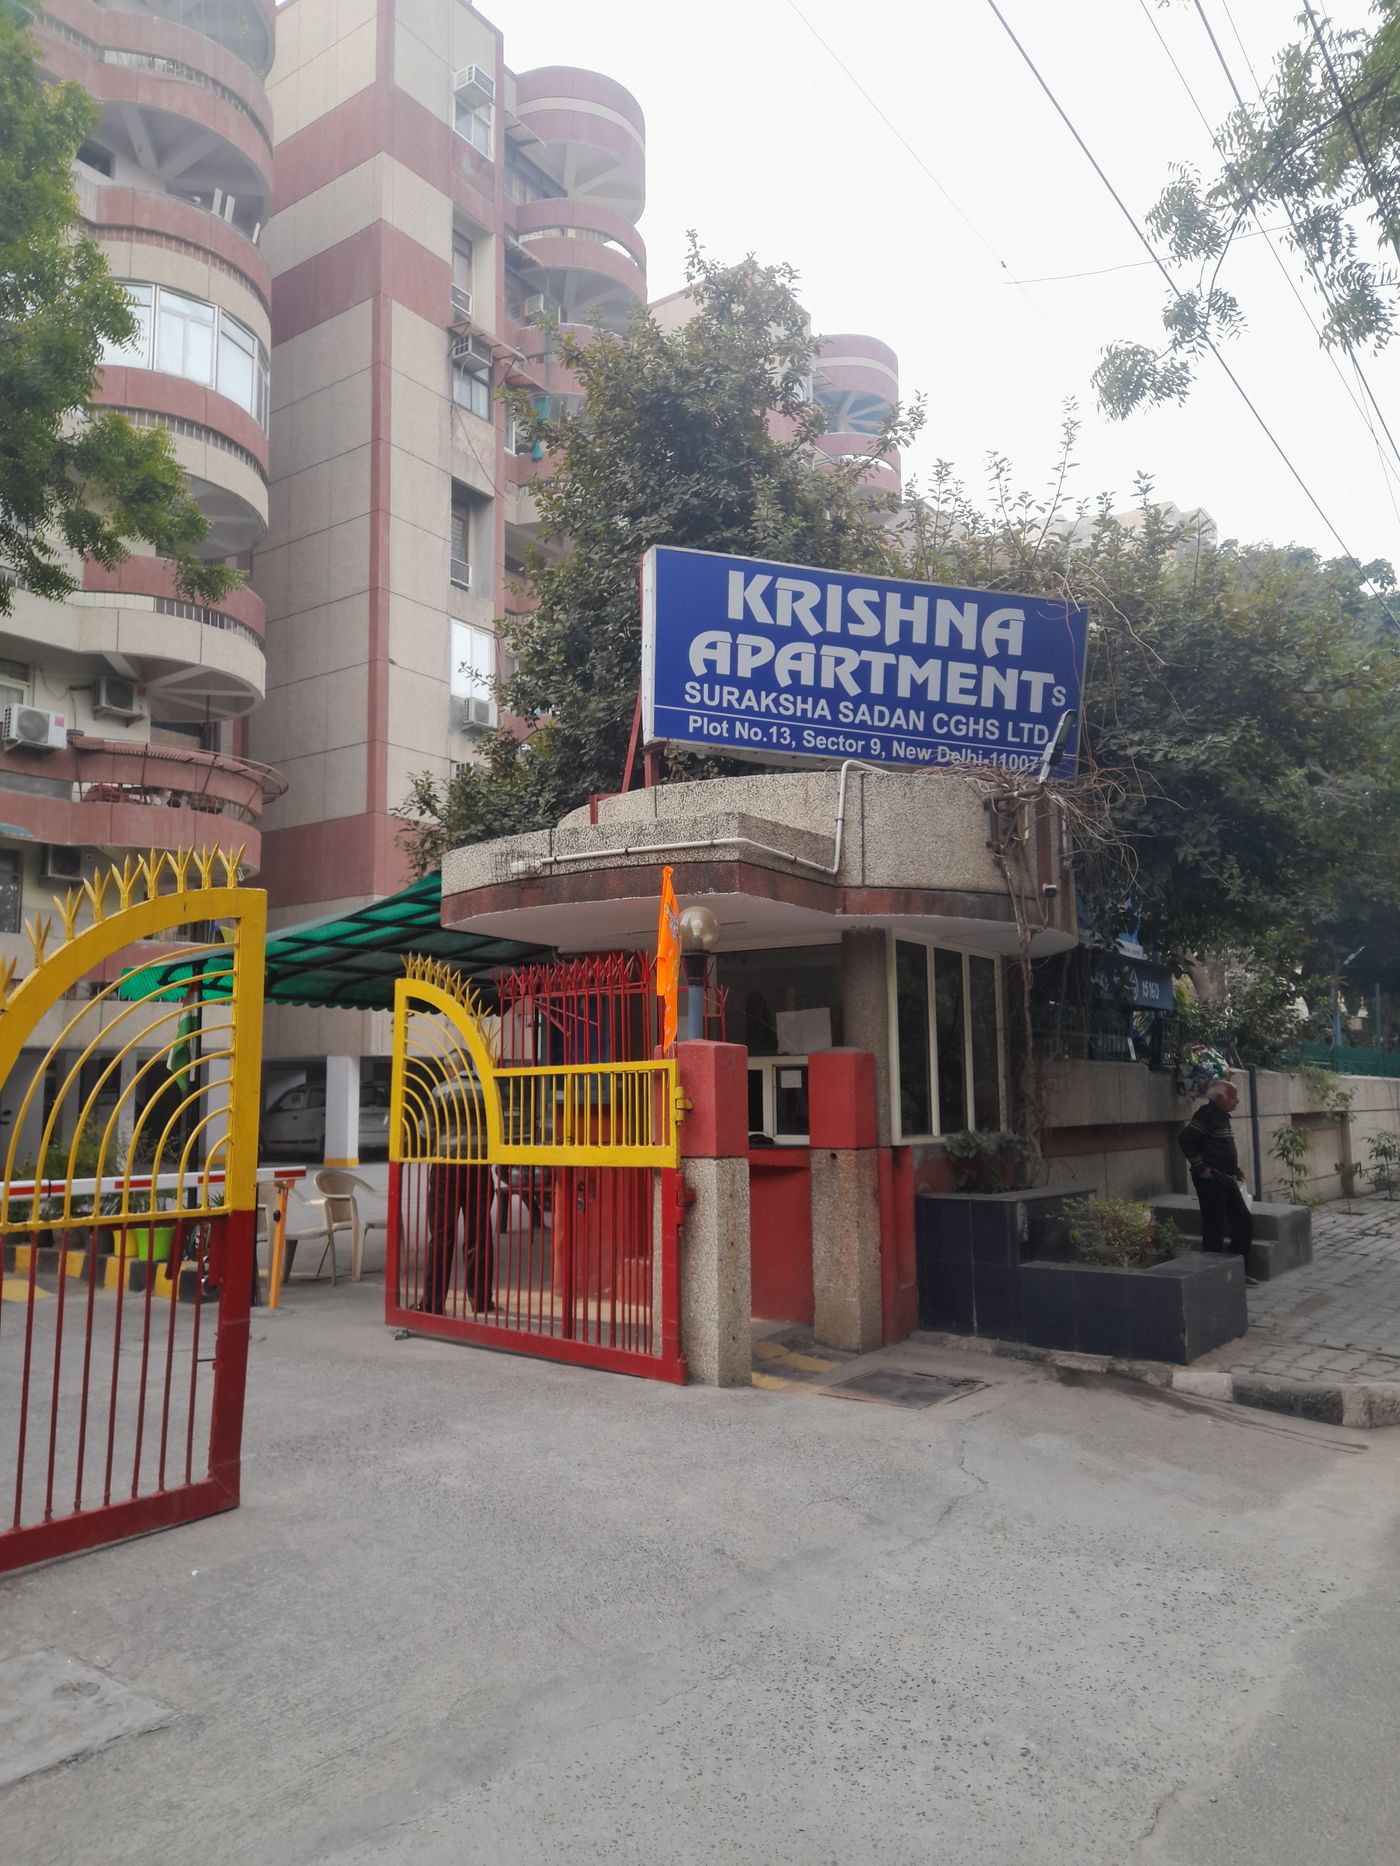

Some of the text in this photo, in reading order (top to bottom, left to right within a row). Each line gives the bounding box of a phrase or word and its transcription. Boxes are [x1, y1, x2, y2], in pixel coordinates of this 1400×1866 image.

[727, 570, 1025, 659] KRISHNA
[684, 681, 832, 721] SURAKSHA
[838, 701, 925, 732] SADAN
[932, 712, 1000, 740] CGHS
[688, 715, 1044, 771] Plot No.13, Sector 9, New Delhi-11007
